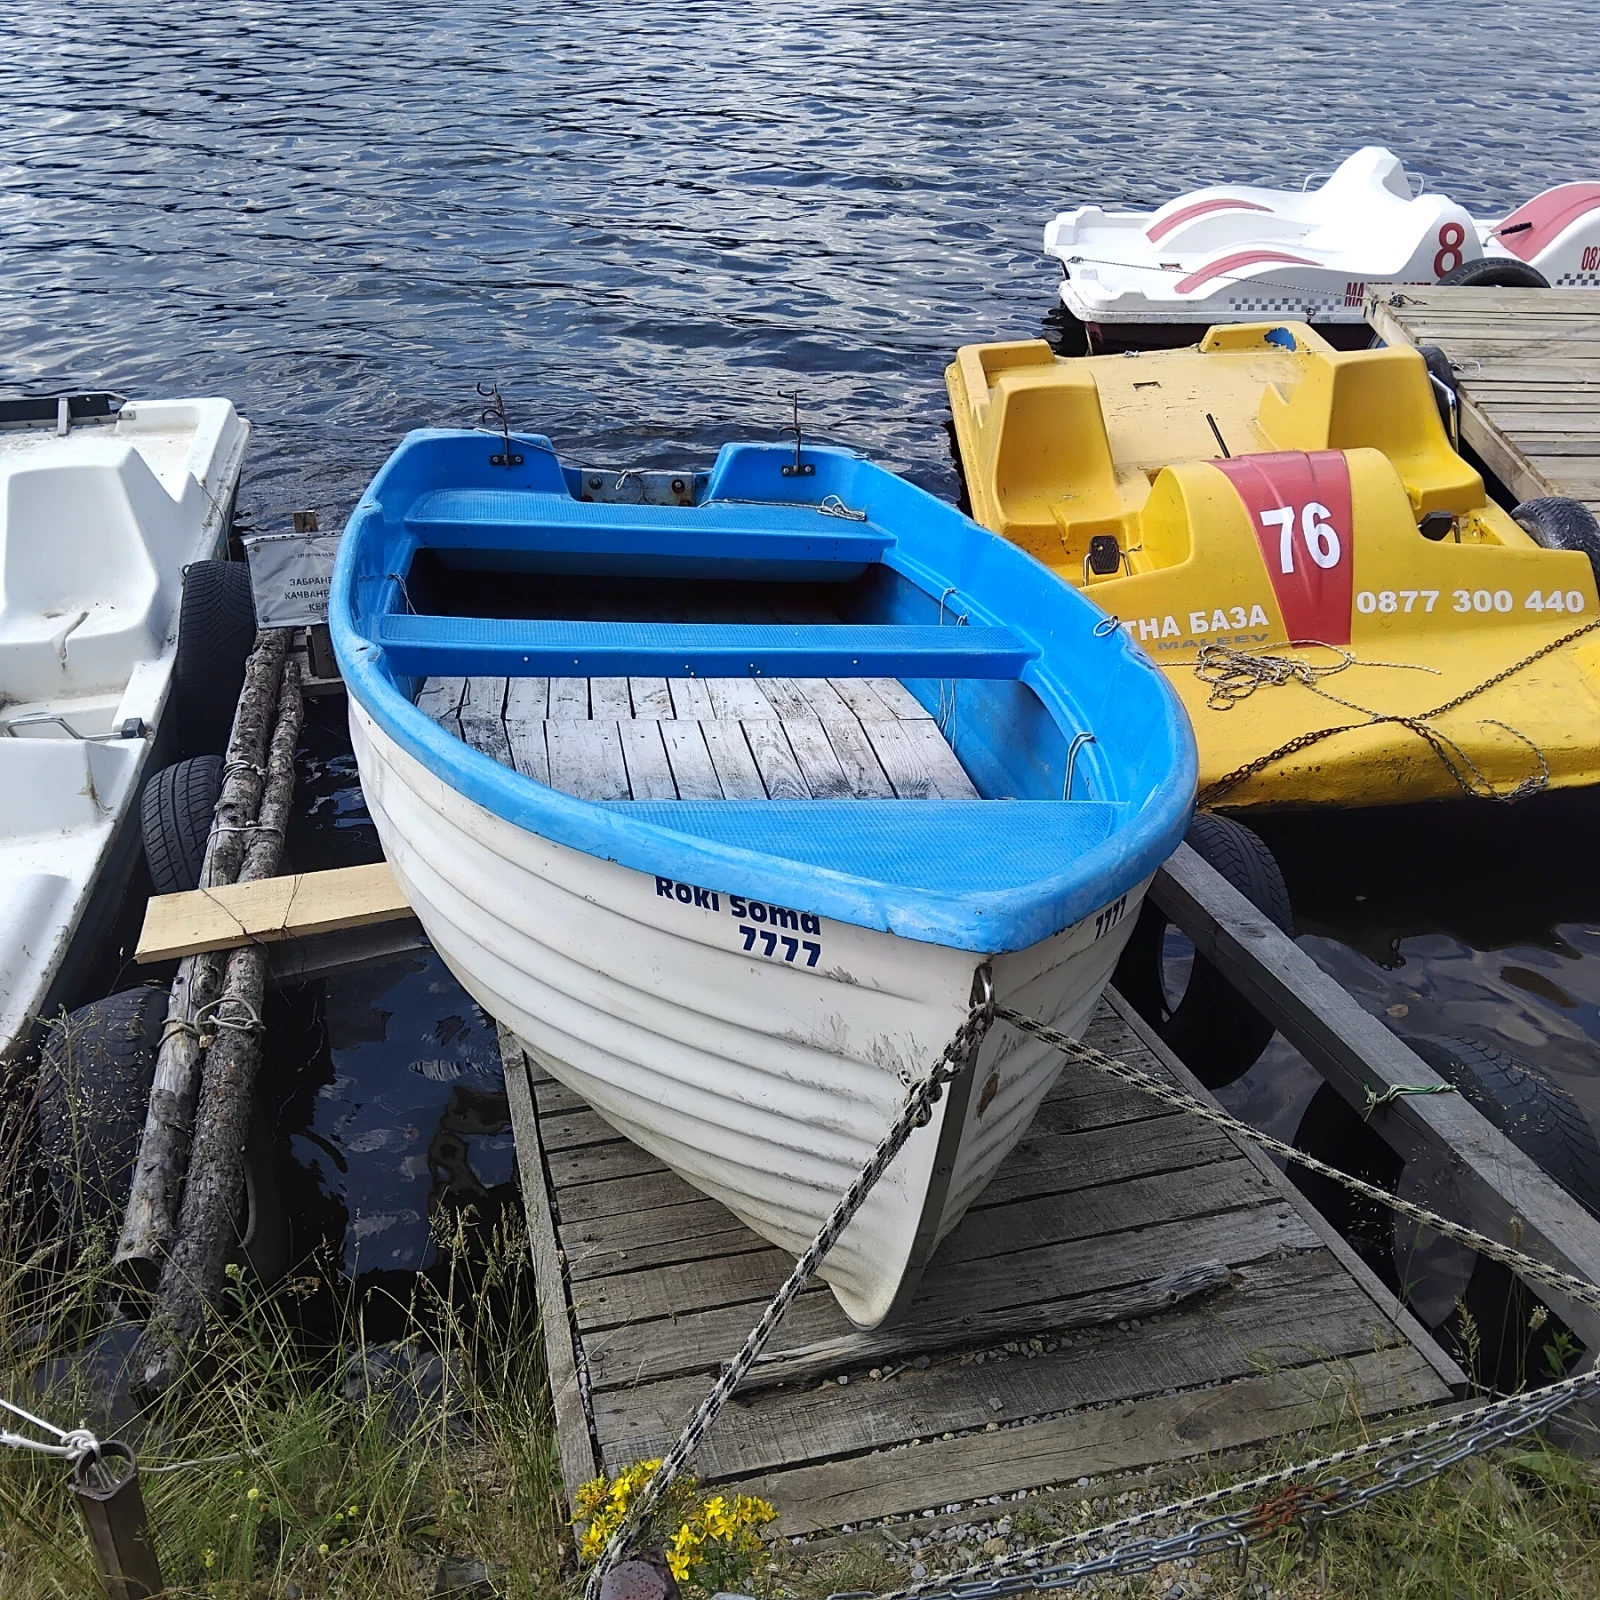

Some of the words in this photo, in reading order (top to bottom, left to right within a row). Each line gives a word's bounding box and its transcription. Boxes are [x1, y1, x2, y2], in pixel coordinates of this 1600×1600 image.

[1433, 221, 1465, 279] 8
[1259, 502, 1341, 574] 76
[308, 602, 329, 611] КЕЯ
[1189, 604, 1270, 634] БАЗА
[1356, 590, 1440, 613] 0877
[1452, 590, 1514, 613] 300
[1524, 590, 1585, 613] 440
[1157, 633, 1269, 650] MALEEV
[729, 893, 821, 936] Soma
[1095, 893, 1128, 941] 7777
[739, 924, 822, 968] 7777
